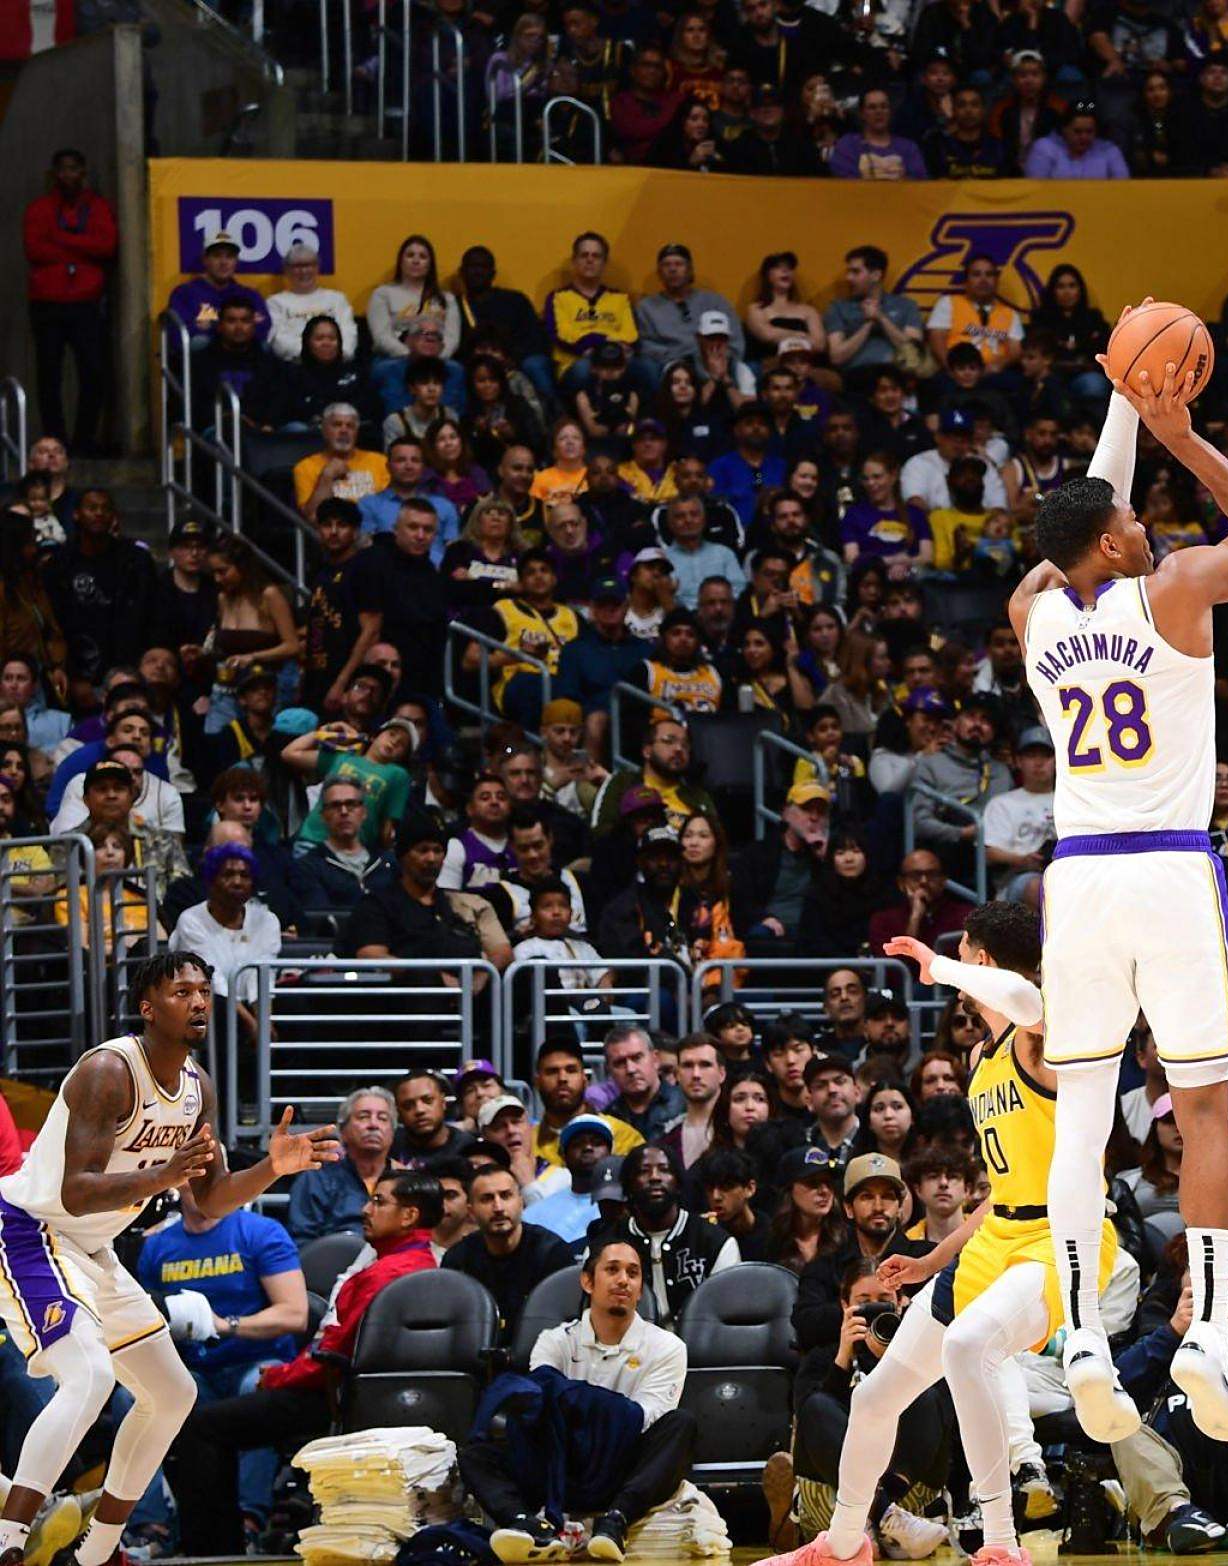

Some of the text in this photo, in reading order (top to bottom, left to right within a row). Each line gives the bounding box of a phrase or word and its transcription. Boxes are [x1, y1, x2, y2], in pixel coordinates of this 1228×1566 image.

[194, 209, 320, 263] 106
[1036, 633, 1154, 685] HACHIMURA
[1059, 678, 1156, 774] 28
[122, 1119, 192, 1152] LAKERS
[161, 1252, 244, 1283] INDIANA
